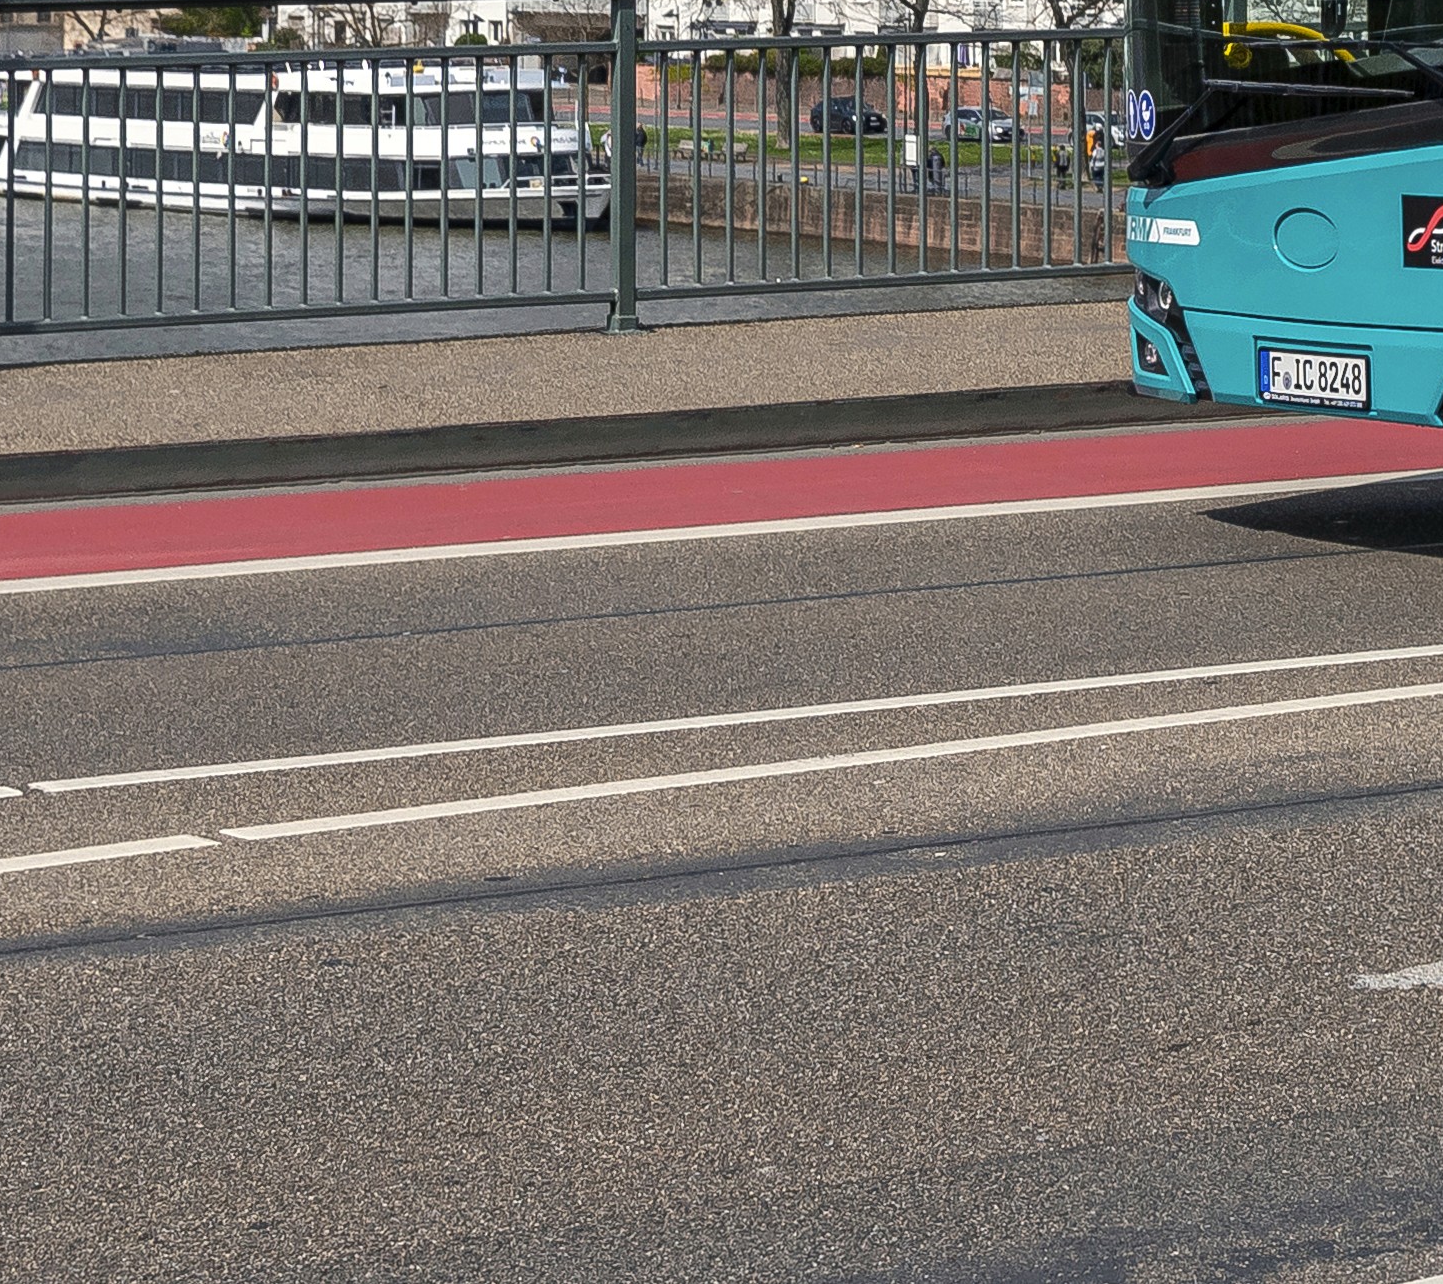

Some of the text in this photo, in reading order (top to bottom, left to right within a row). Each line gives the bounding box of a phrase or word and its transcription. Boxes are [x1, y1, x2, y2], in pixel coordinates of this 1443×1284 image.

[1271, 356, 1362, 395] F IC 8248
